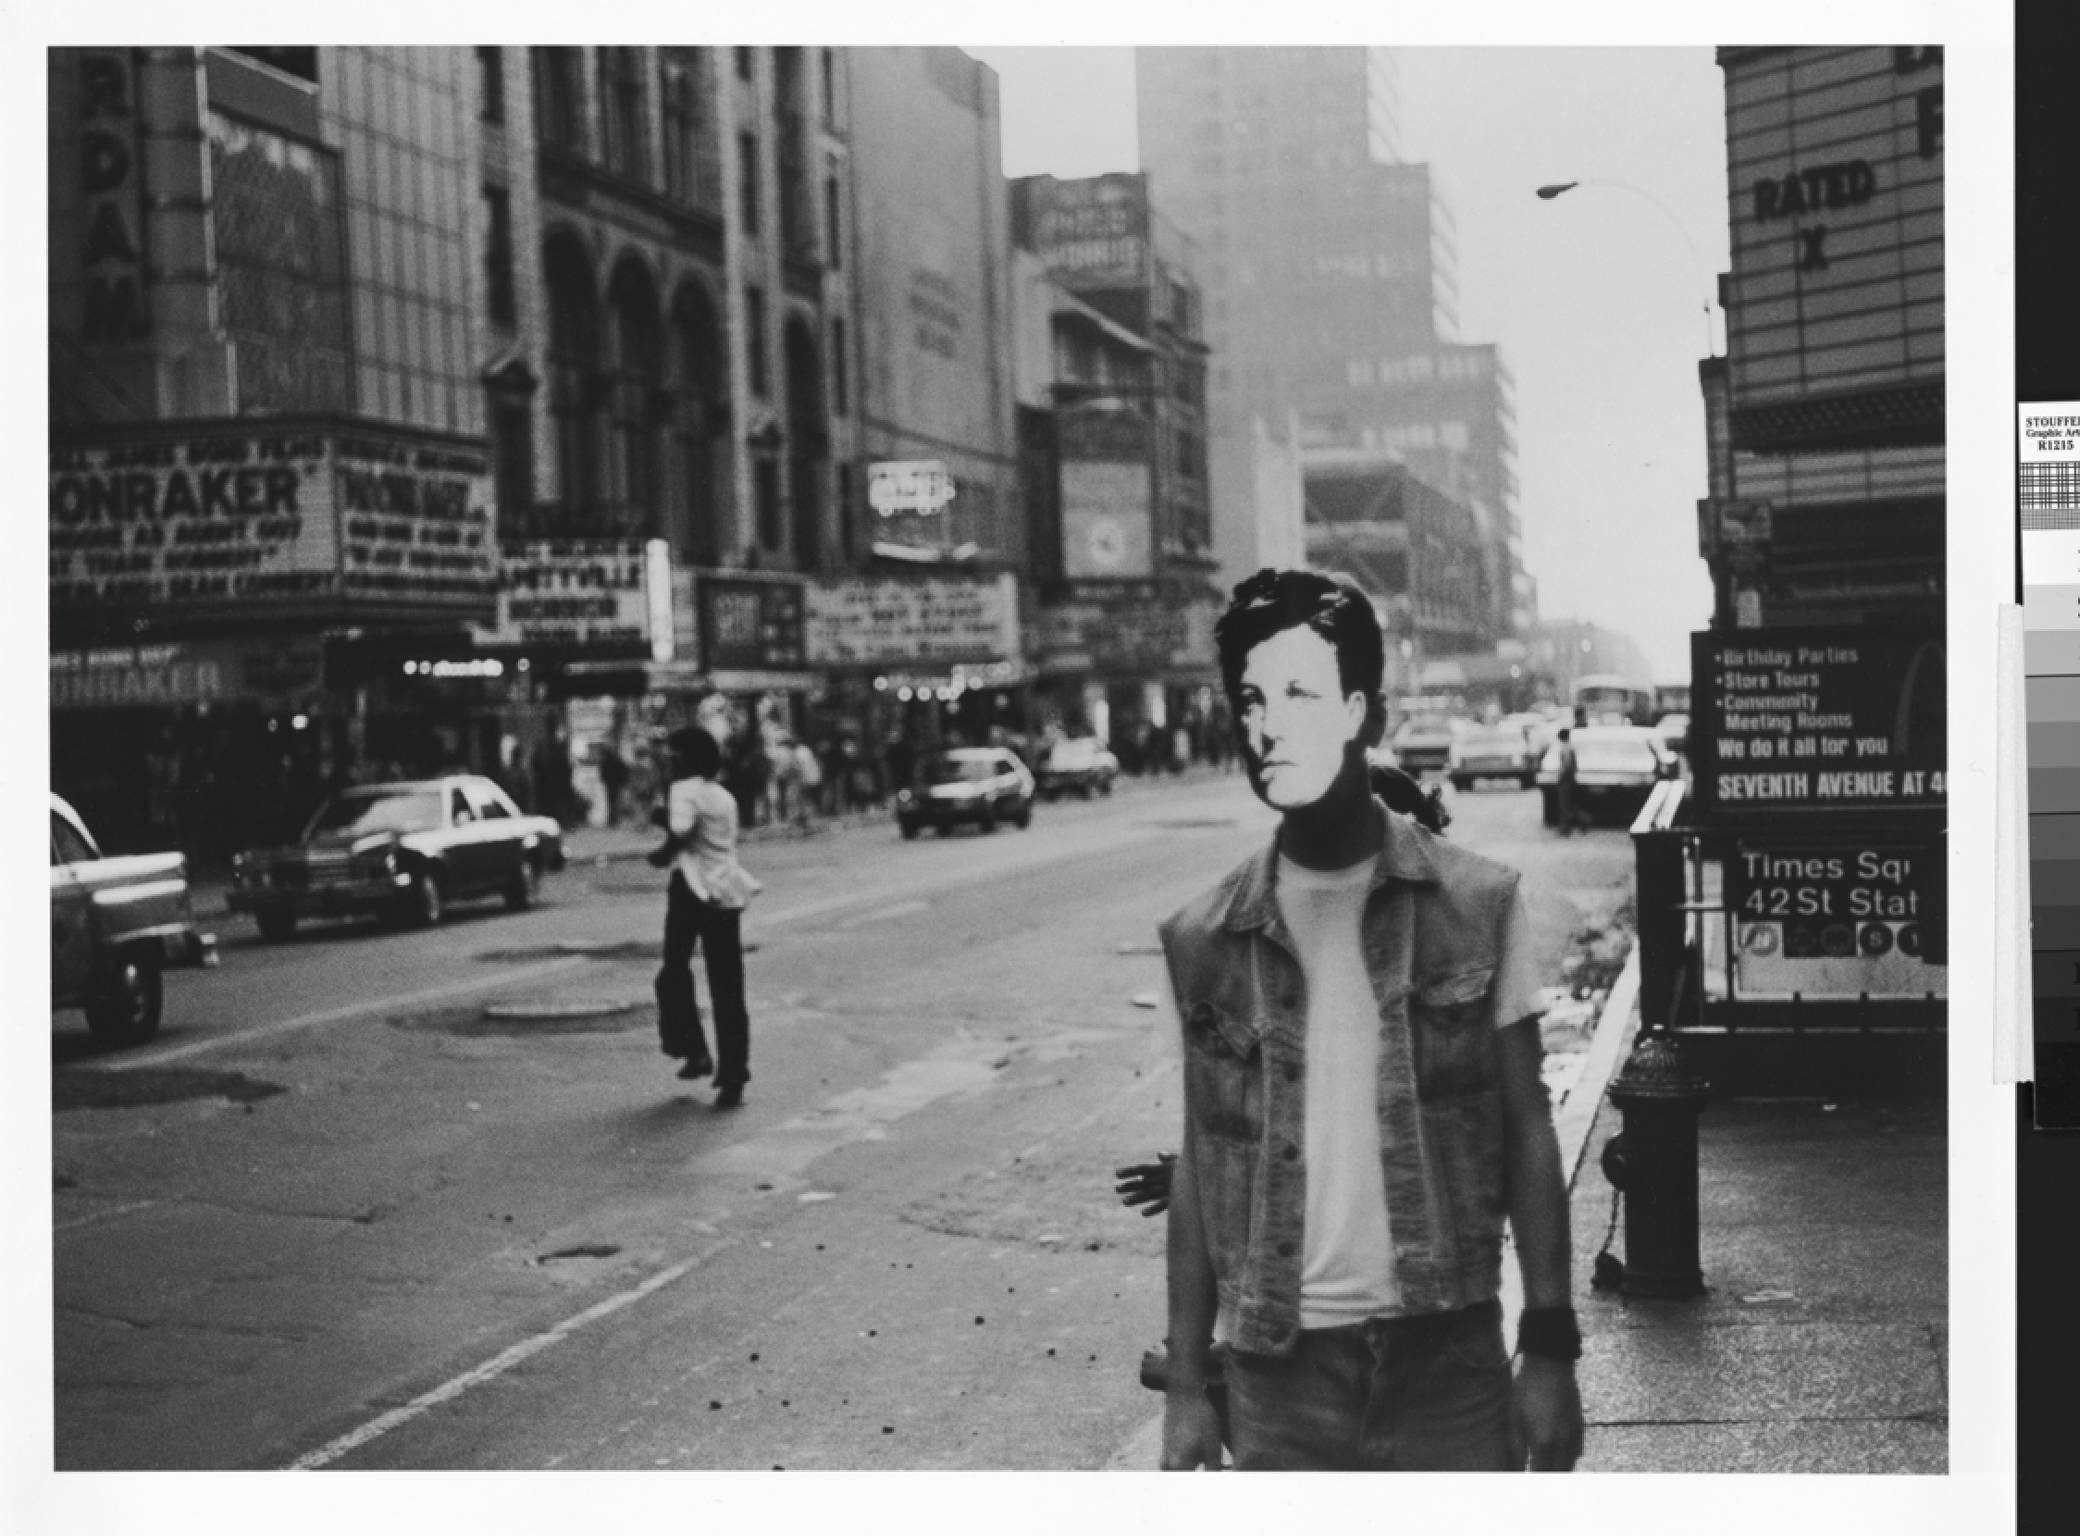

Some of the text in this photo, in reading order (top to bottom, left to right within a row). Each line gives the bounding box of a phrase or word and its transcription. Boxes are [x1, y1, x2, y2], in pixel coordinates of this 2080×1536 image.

[1754, 158, 1876, 222] RATED
[1800, 223, 1829, 273] X
[2025, 416, 2080, 428] STOUFFE
[2025, 428, 2062, 439] Graphic
[2037, 440, 2075, 451] R1215
[1723, 647, 1858, 668] Birthday Parties
[1724, 670, 1820, 689] Store Tours
[1724, 692, 1819, 712] Community
[1725, 711, 1853, 734] Meeting Rooms
[1717, 738, 1746, 759] We
[1750, 737, 1773, 758] do
[1794, 736, 1817, 756] all
[1821, 735, 1849, 756] for
[1856, 737, 1888, 758] you
[1718, 773, 1809, 800] SEVENTH
[1816, 771, 1895, 798] AVENUE
[1902, 770, 1926, 796] AT
[1741, 852, 1845, 880] Times
